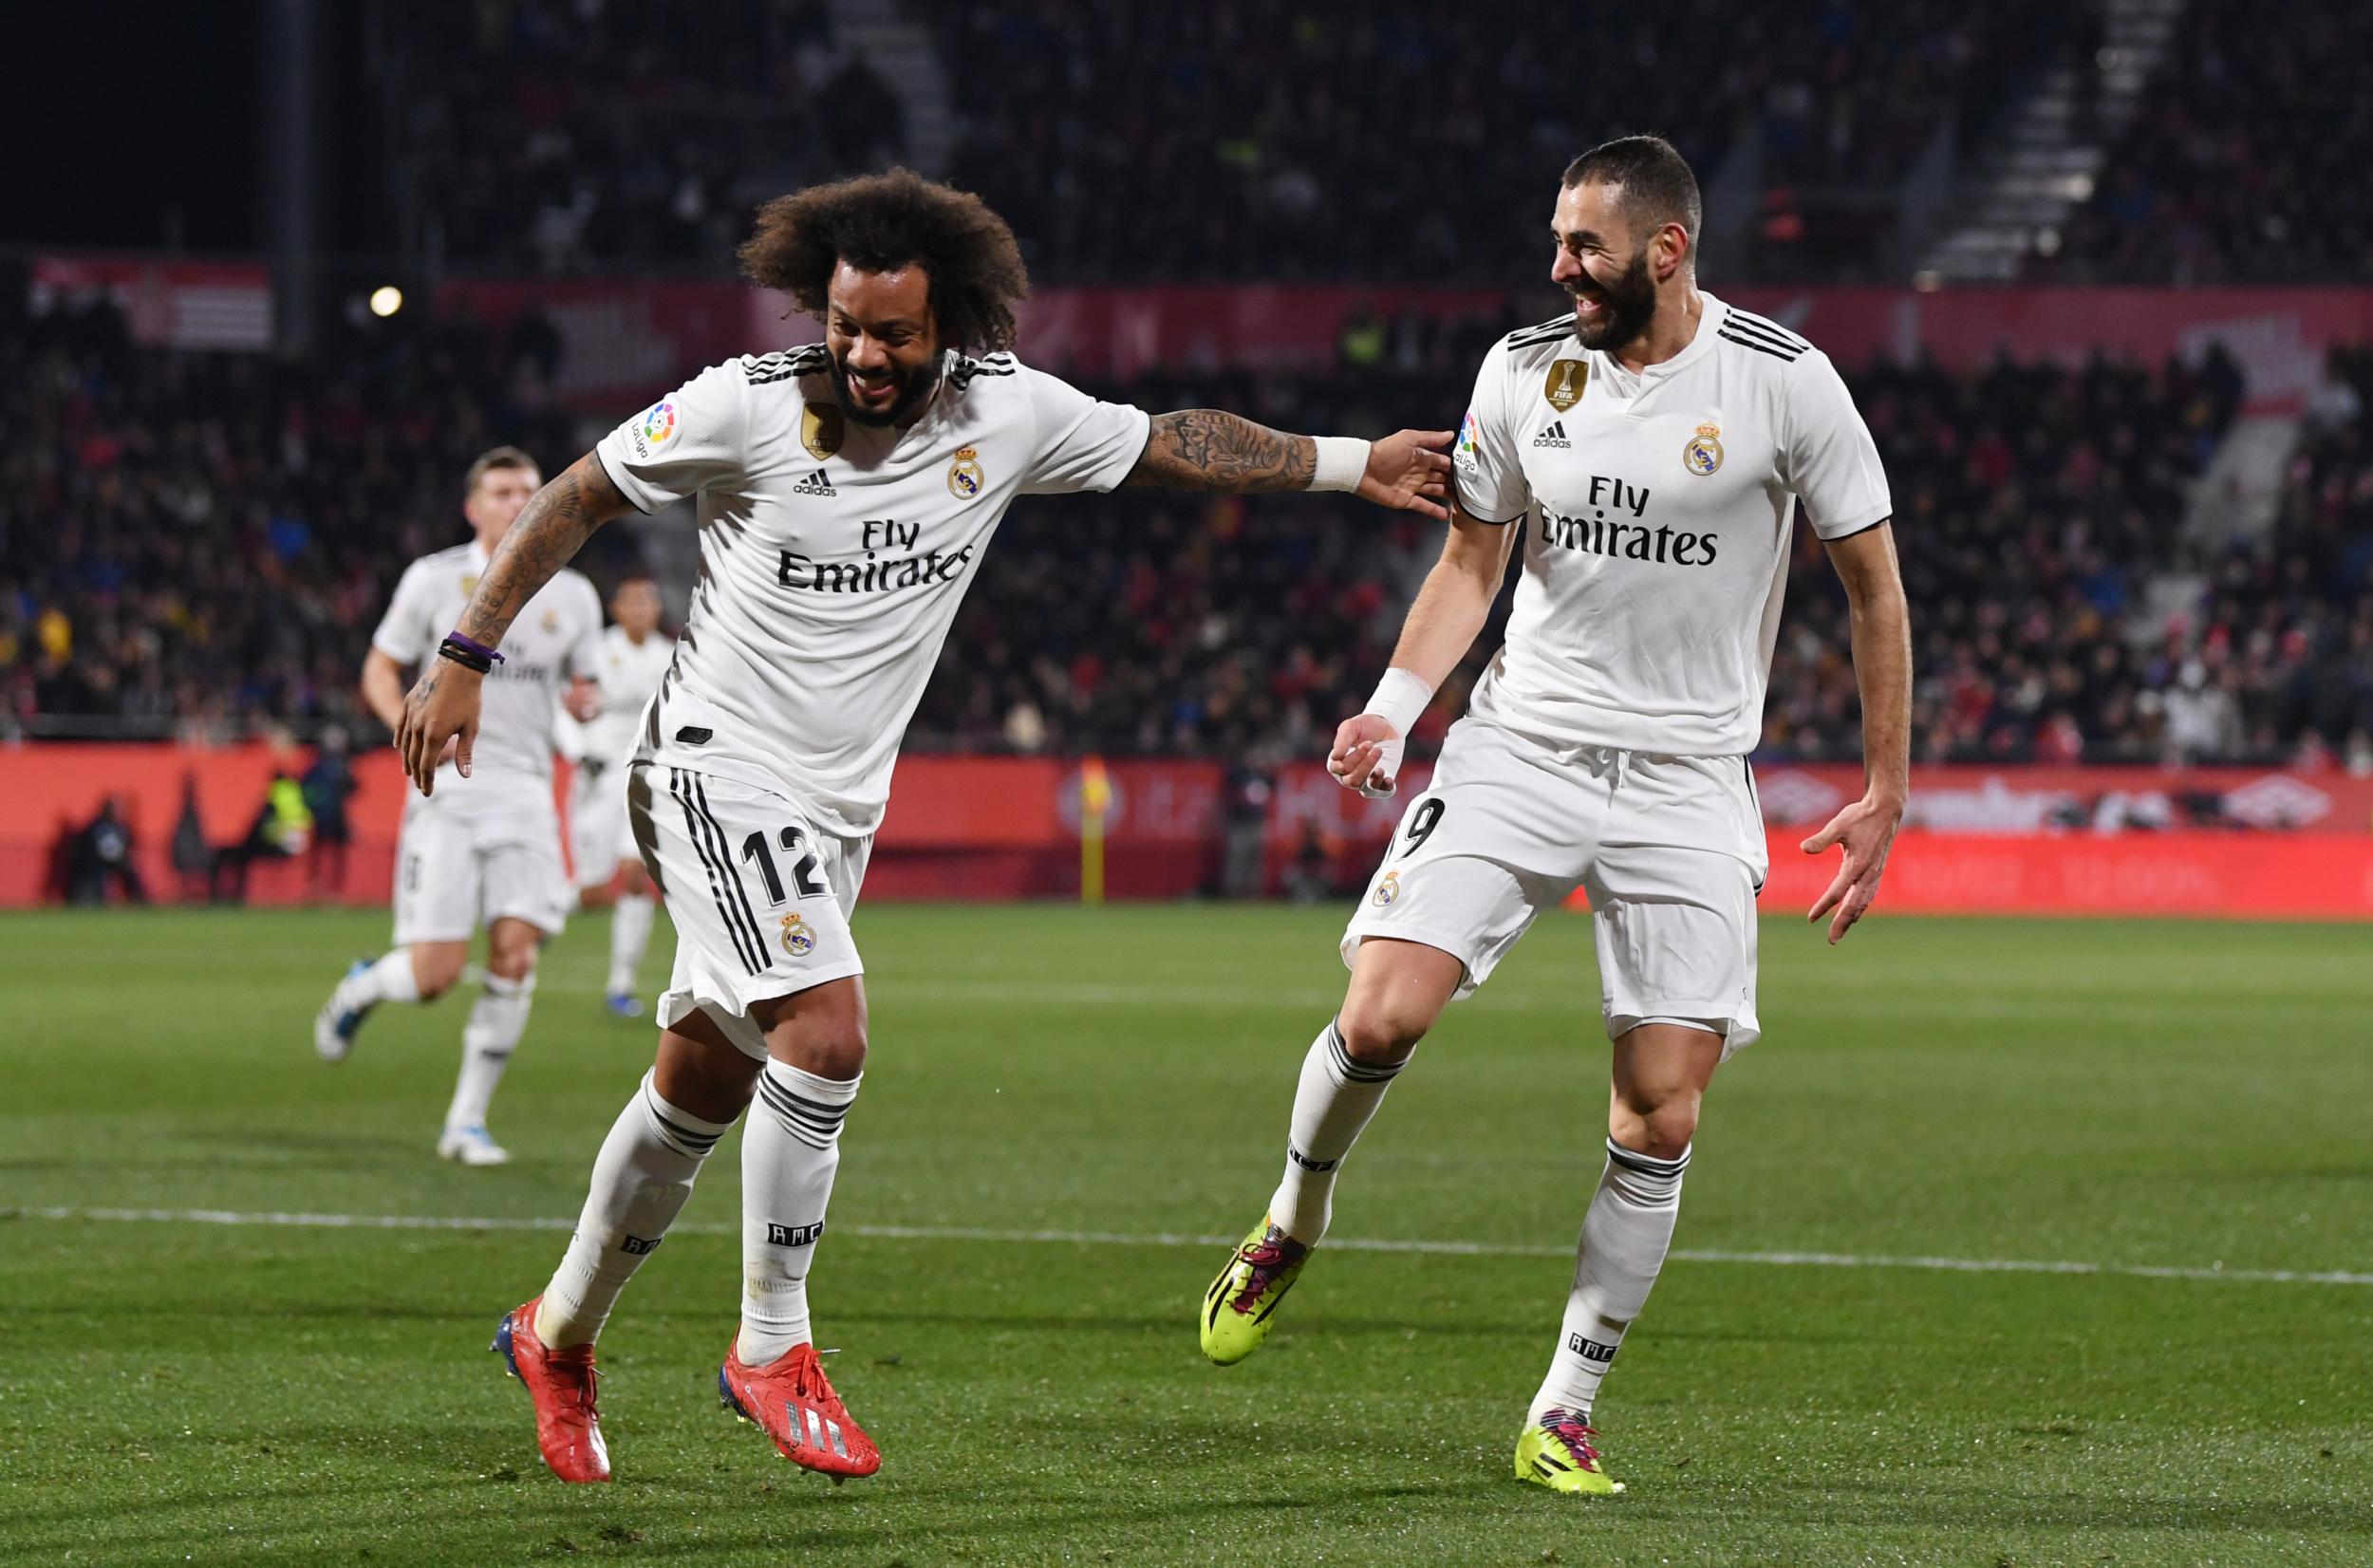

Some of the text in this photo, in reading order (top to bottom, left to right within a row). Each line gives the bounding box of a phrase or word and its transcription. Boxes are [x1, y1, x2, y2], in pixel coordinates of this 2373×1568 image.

[632, 421, 648, 458] LaLiga
[1533, 437, 1572, 449] adidas
[1454, 454, 1476, 471] aLiga
[793, 484, 837, 497] adidas
[1589, 475, 1650, 517] Fly
[862, 519, 920, 551] Fly
[1540, 503, 1718, 566] Emirates
[778, 545, 974, 593] Emirates
[739, 826, 828, 908] 12
